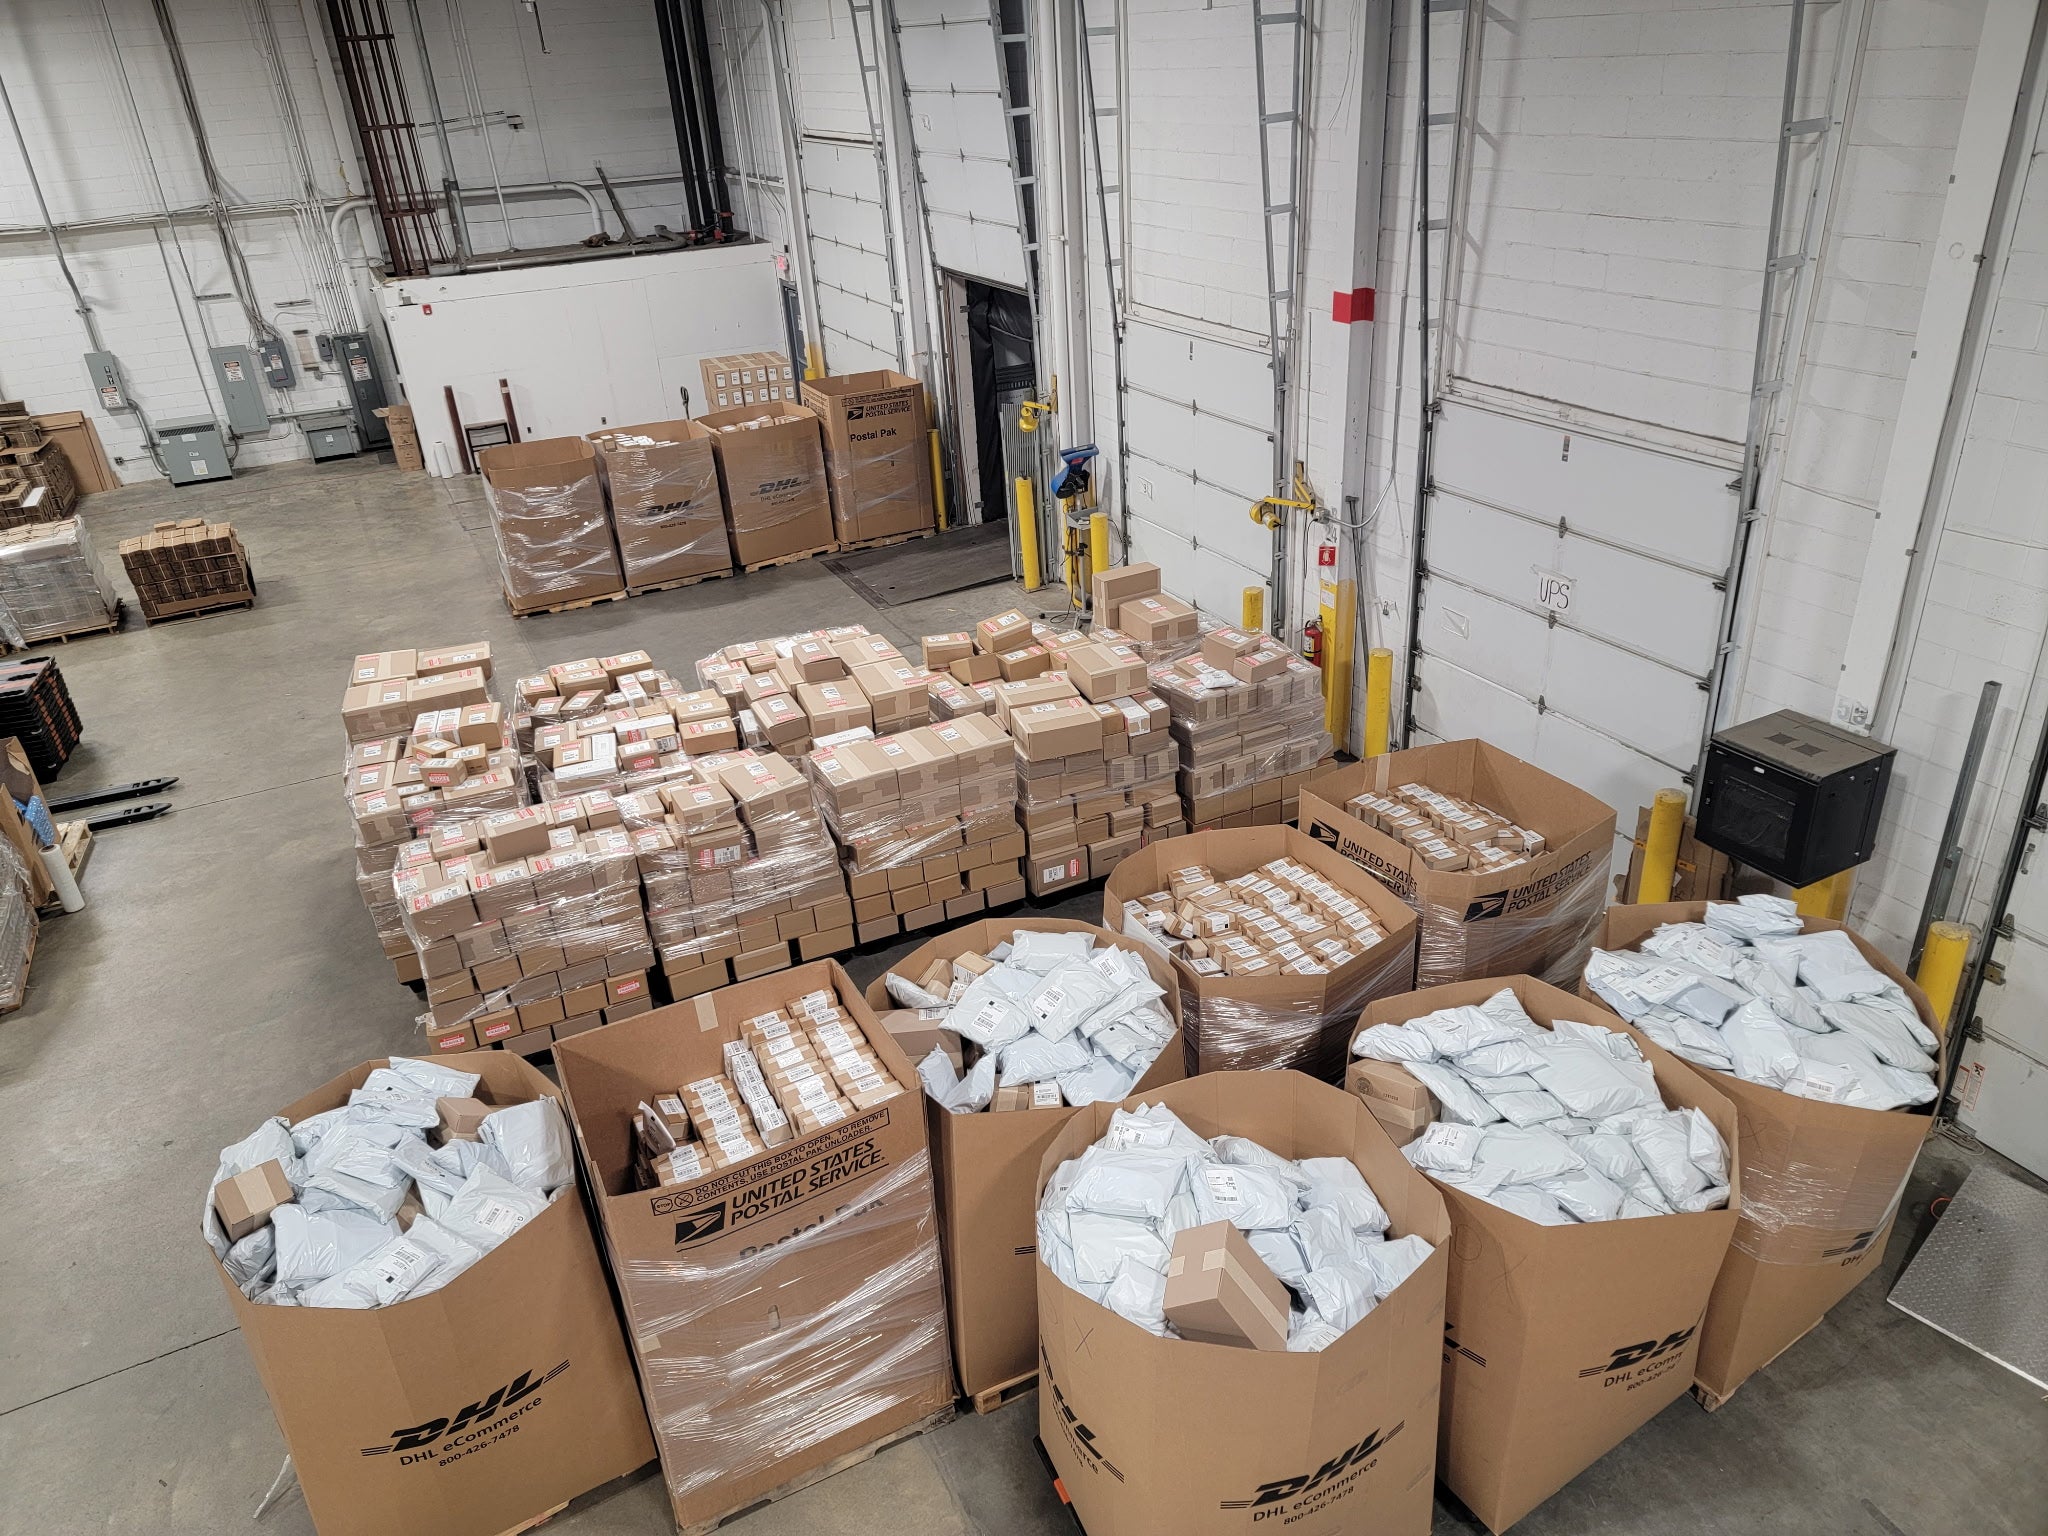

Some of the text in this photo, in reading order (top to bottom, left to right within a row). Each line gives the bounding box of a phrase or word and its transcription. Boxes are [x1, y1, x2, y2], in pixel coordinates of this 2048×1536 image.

[865, 403, 888, 411] UNITED
[865, 405, 911, 418] POSTAL SERVICE
[850, 427, 897, 442] Postal Pak
[758, 477, 802, 494] DHL
[1540, 577, 1569, 609] UPS
[1343, 837, 1418, 893] UNITED STATES
[1506, 864, 1592, 913] POSTAL SERVICE
[1512, 850, 1592, 899] UNITED STATES
[695, 1185, 709, 1195] DO
[712, 1175, 731, 1189] NOT
[732, 1167, 751, 1180] CUT
[751, 1159, 773, 1172] THIS
[774, 1150, 794, 1163] BOX
[794, 1144, 806, 1154] TO
[837, 1126, 849, 1136] TO
[851, 1110, 885, 1131] REMOVE
[696, 1125, 873, 1202] CONTENTS, USE POSTAL PAK UNLOADER.
[732, 1137, 875, 1209] UNITED STATES
[731, 1186, 805, 1226] POSTAL
[1604, 1322, 1699, 1373] DH
[1603, 1371, 1633, 1388] DHL
[390, 1368, 545, 1453] DHL
[399, 1396, 543, 1466] DHL eCommerce
[438, 1424, 521, 1467] 800-426-7478
[1250, 1427, 1386, 1508] DHL
[1253, 1457, 1379, 1523] DHL eCommerce
[1283, 1485, 1355, 1526] 800-426-7478
